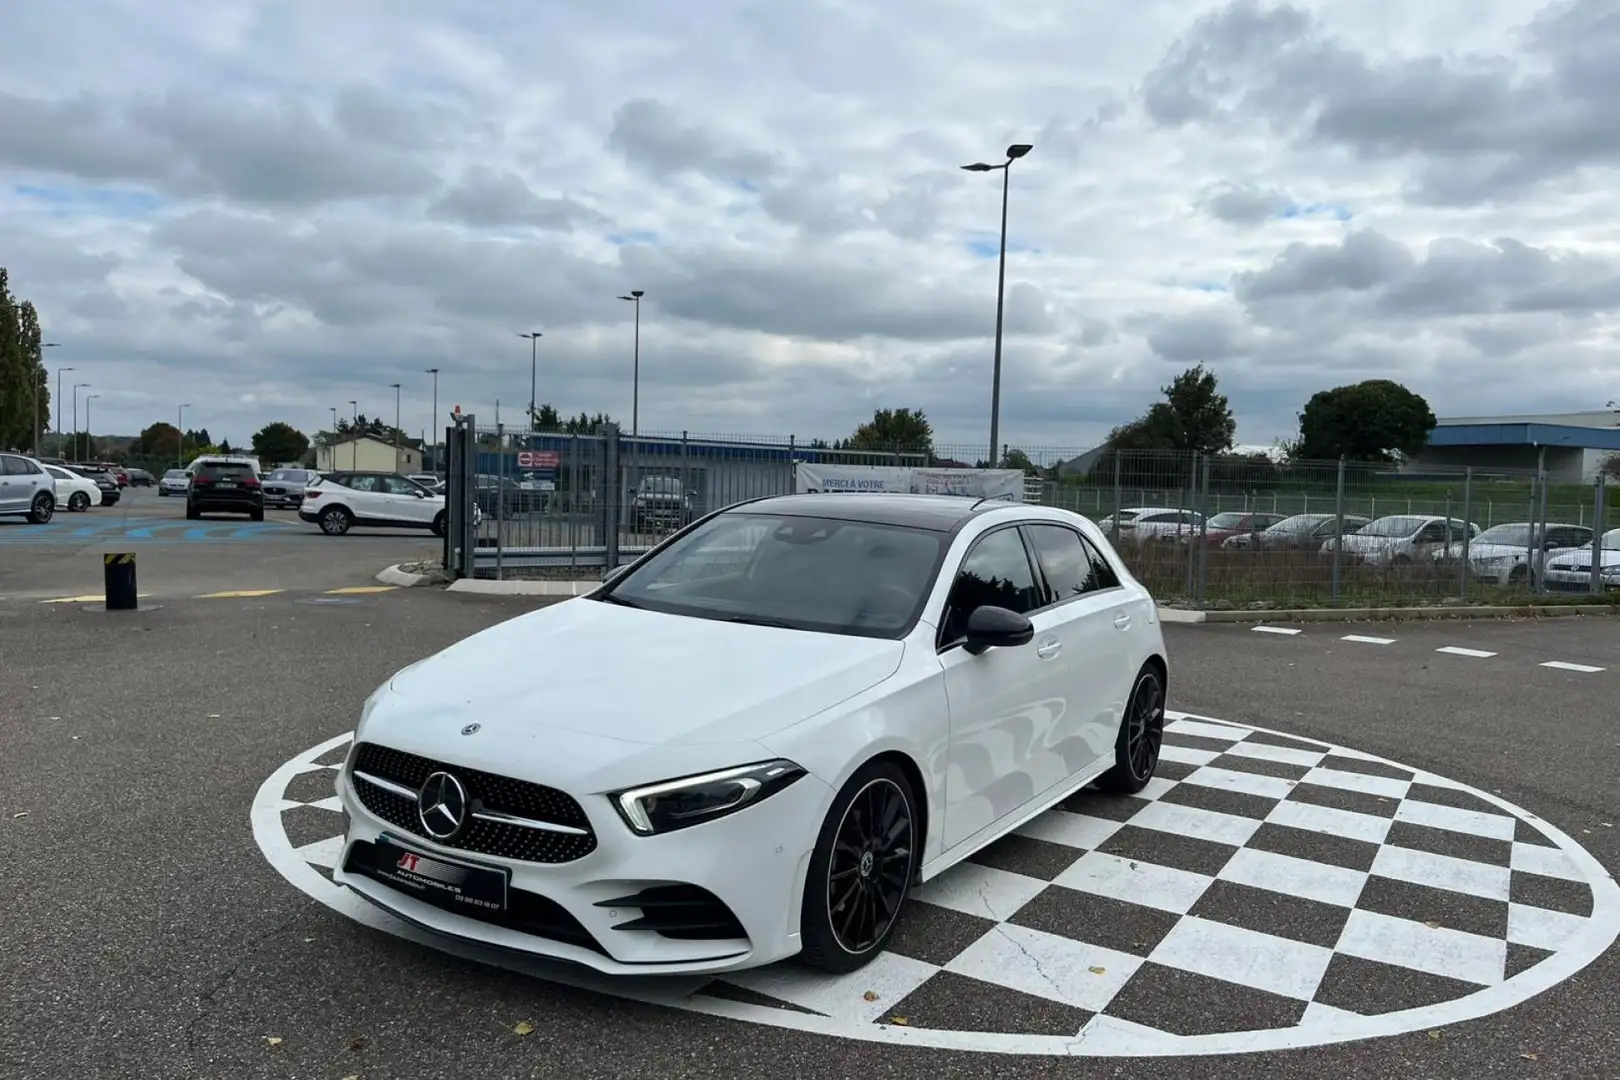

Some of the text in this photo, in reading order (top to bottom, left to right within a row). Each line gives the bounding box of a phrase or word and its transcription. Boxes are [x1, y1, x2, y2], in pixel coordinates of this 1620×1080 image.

[822, 479, 849, 489] MERCI
[859, 480, 885, 489] VOTRE
[397, 853, 419, 872] JT
[396, 870, 461, 893] AUTOMOBILES
